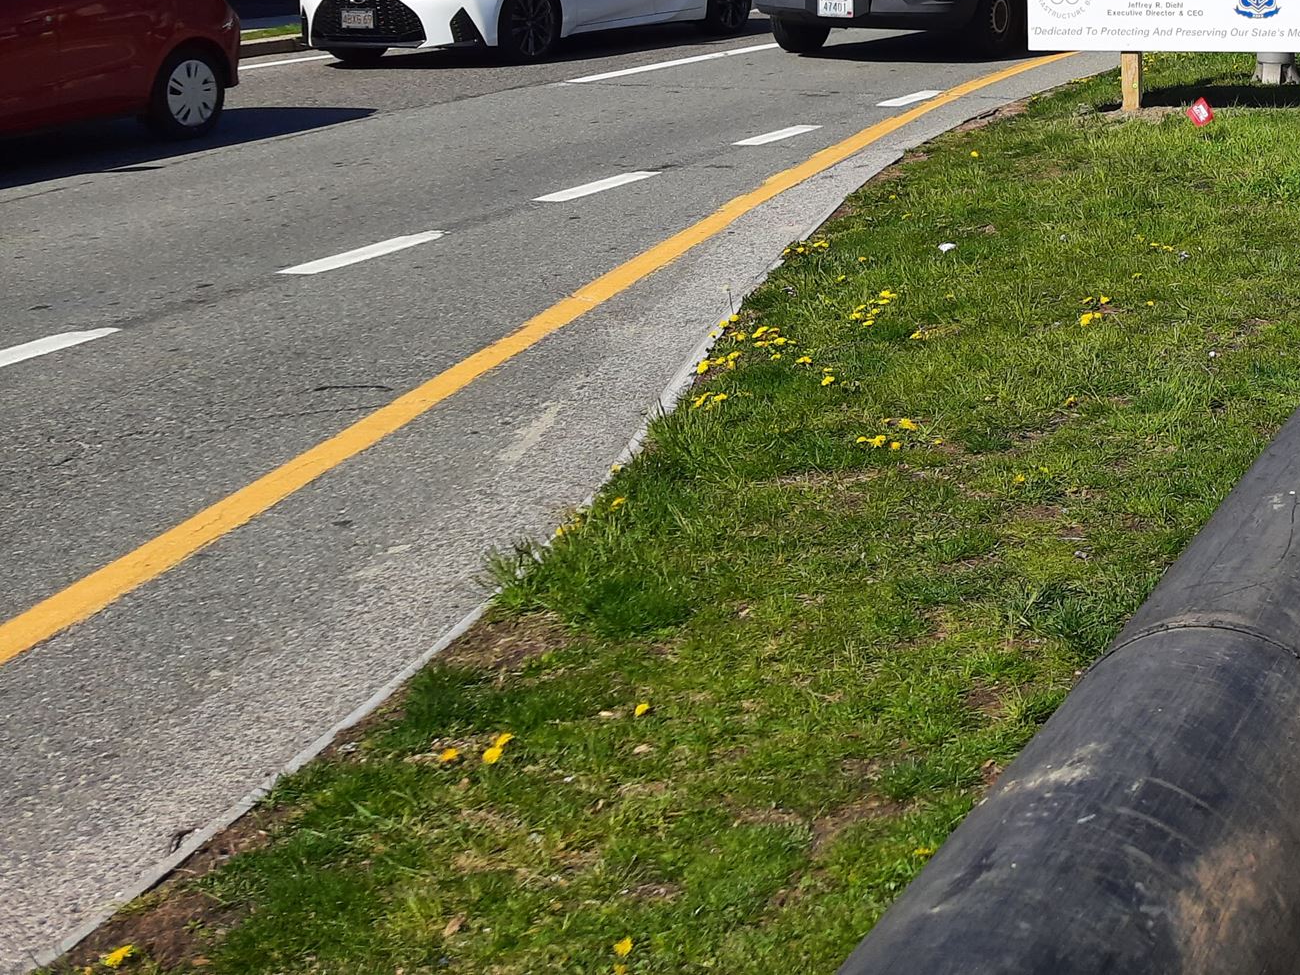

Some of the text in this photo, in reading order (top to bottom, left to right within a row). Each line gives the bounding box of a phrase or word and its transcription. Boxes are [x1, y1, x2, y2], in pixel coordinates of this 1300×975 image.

[824, 1, 846, 12] 47401
[1086, 27, 1097, 36] To
[1101, 27, 1149, 37] Protecting
[1153, 28, 1172, 36] And
[1176, 28, 1227, 38] Preserving
[1231, 28, 1249, 37] Our
[1252, 28, 1284, 37] State's
